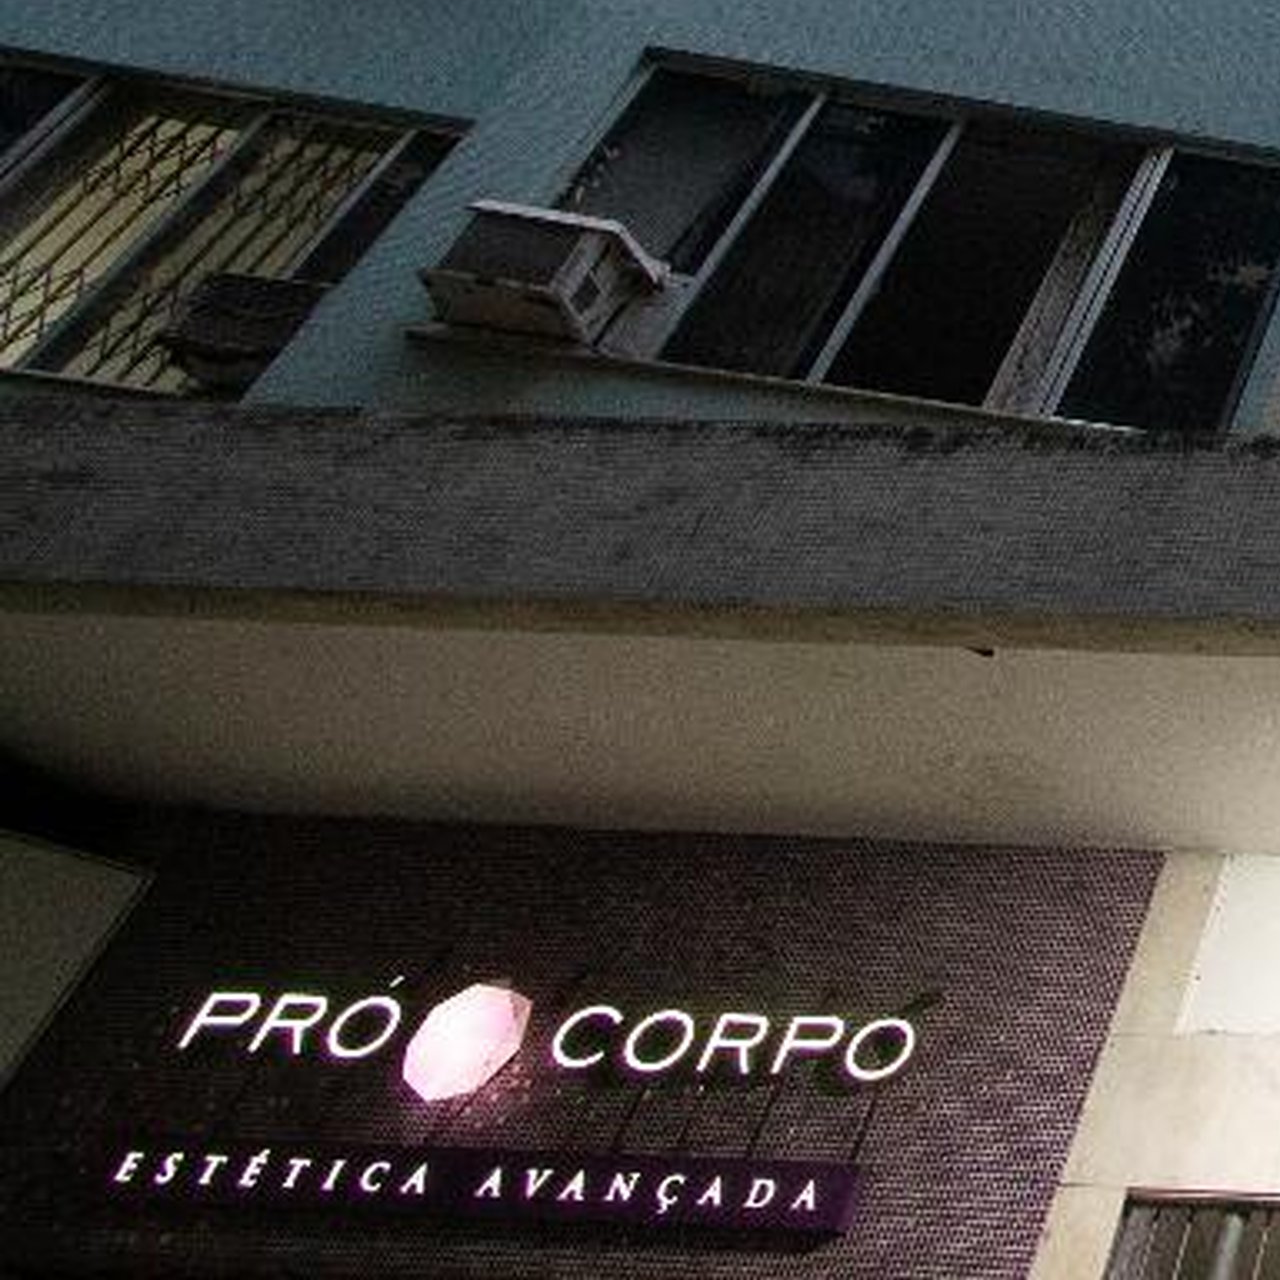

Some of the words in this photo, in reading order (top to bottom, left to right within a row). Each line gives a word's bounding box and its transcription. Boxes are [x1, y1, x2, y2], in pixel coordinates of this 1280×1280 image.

[177, 974, 405, 1059] PRÓ
[551, 1003, 915, 1081] CORPO
[112, 1148, 429, 1195] ESTÉTICA
[473, 1167, 817, 1215] AVANÇADA
